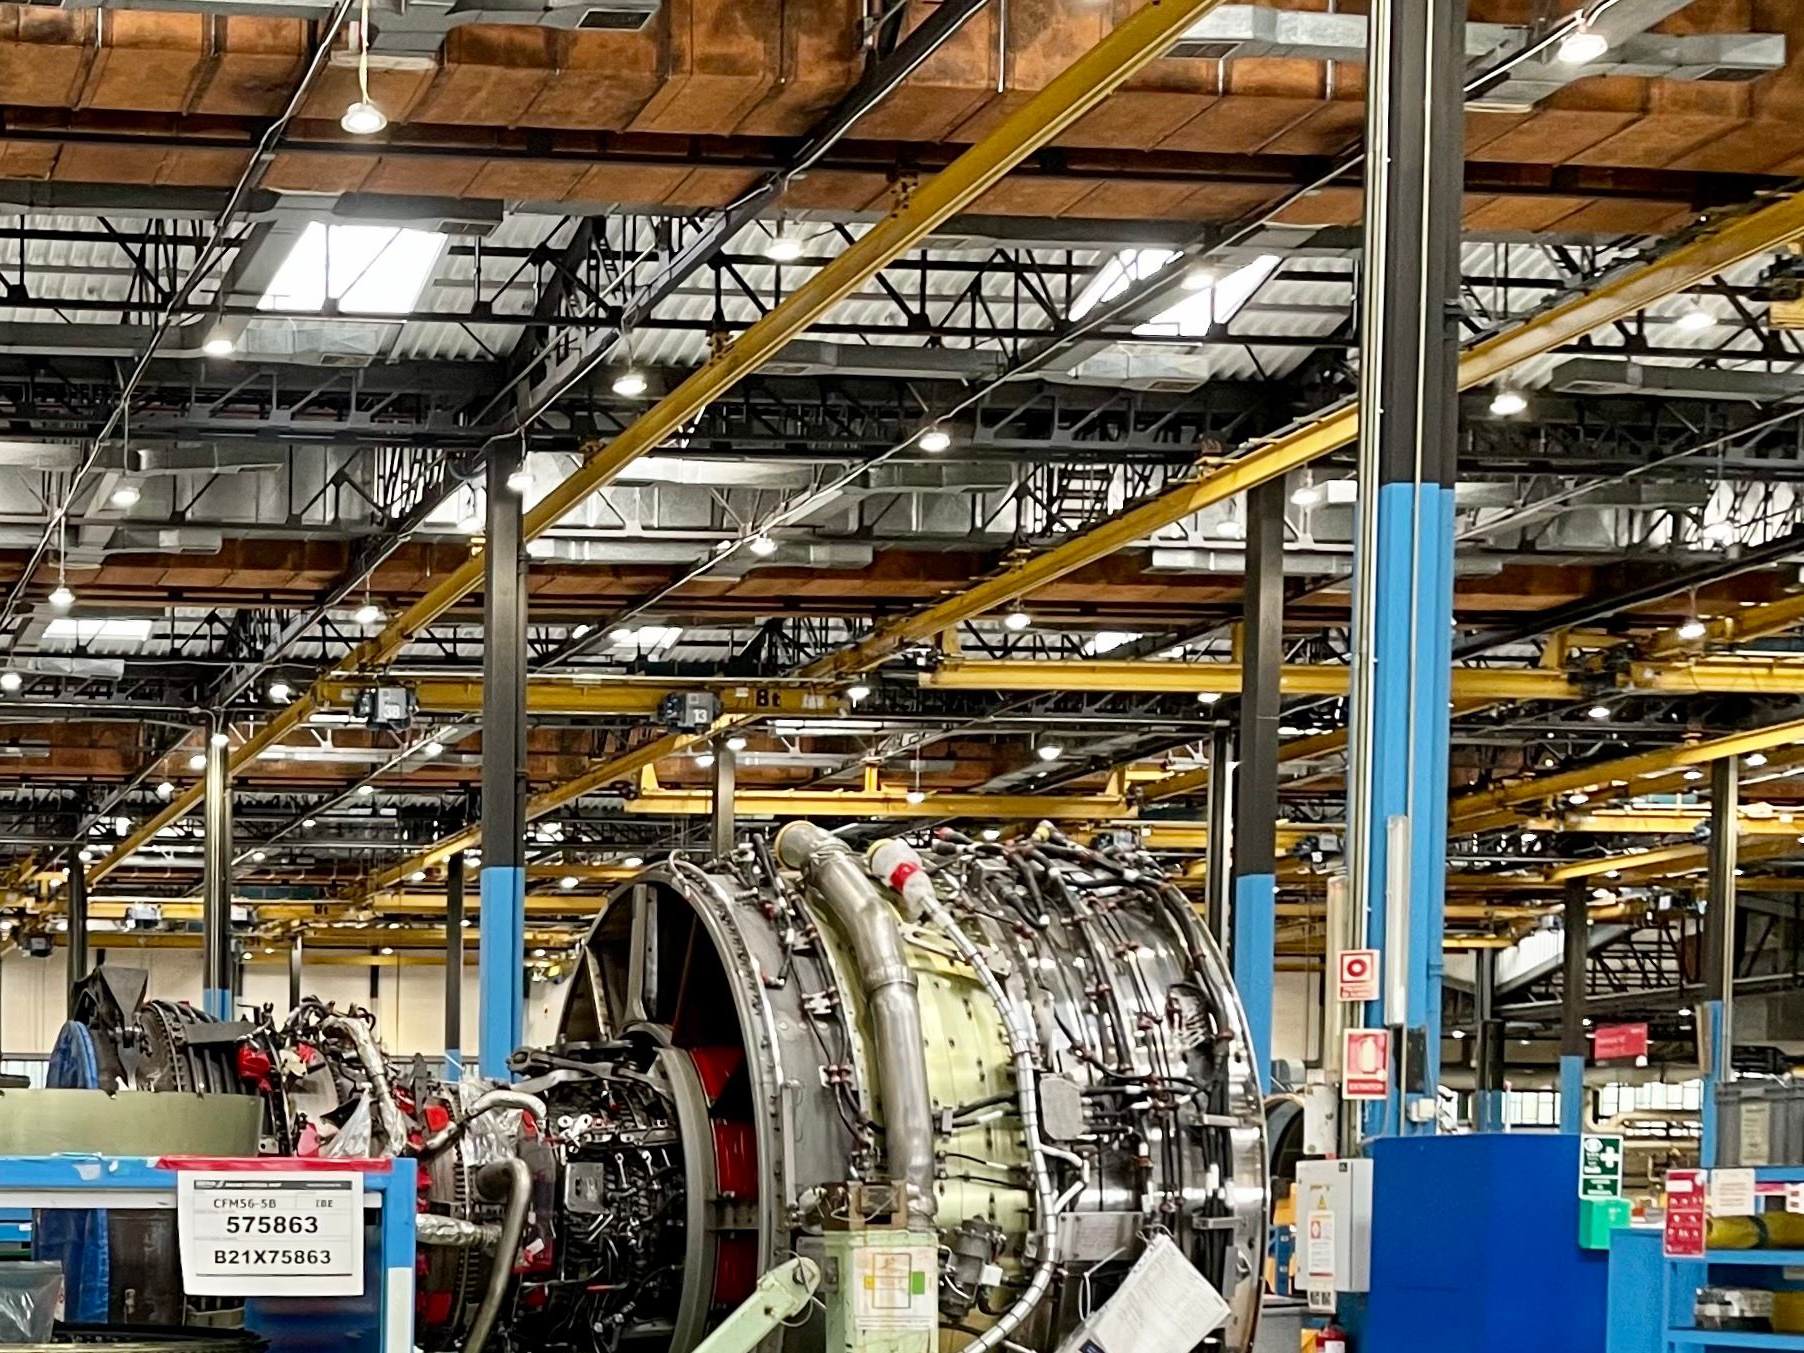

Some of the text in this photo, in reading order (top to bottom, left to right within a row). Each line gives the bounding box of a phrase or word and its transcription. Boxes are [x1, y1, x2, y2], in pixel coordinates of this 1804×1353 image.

[693, 709, 707, 723] 13
[213, 1199, 277, 1209] CFM56-5B
[226, 1215, 319, 1234] 575863
[214, 1250, 331, 1264] B21X75863
